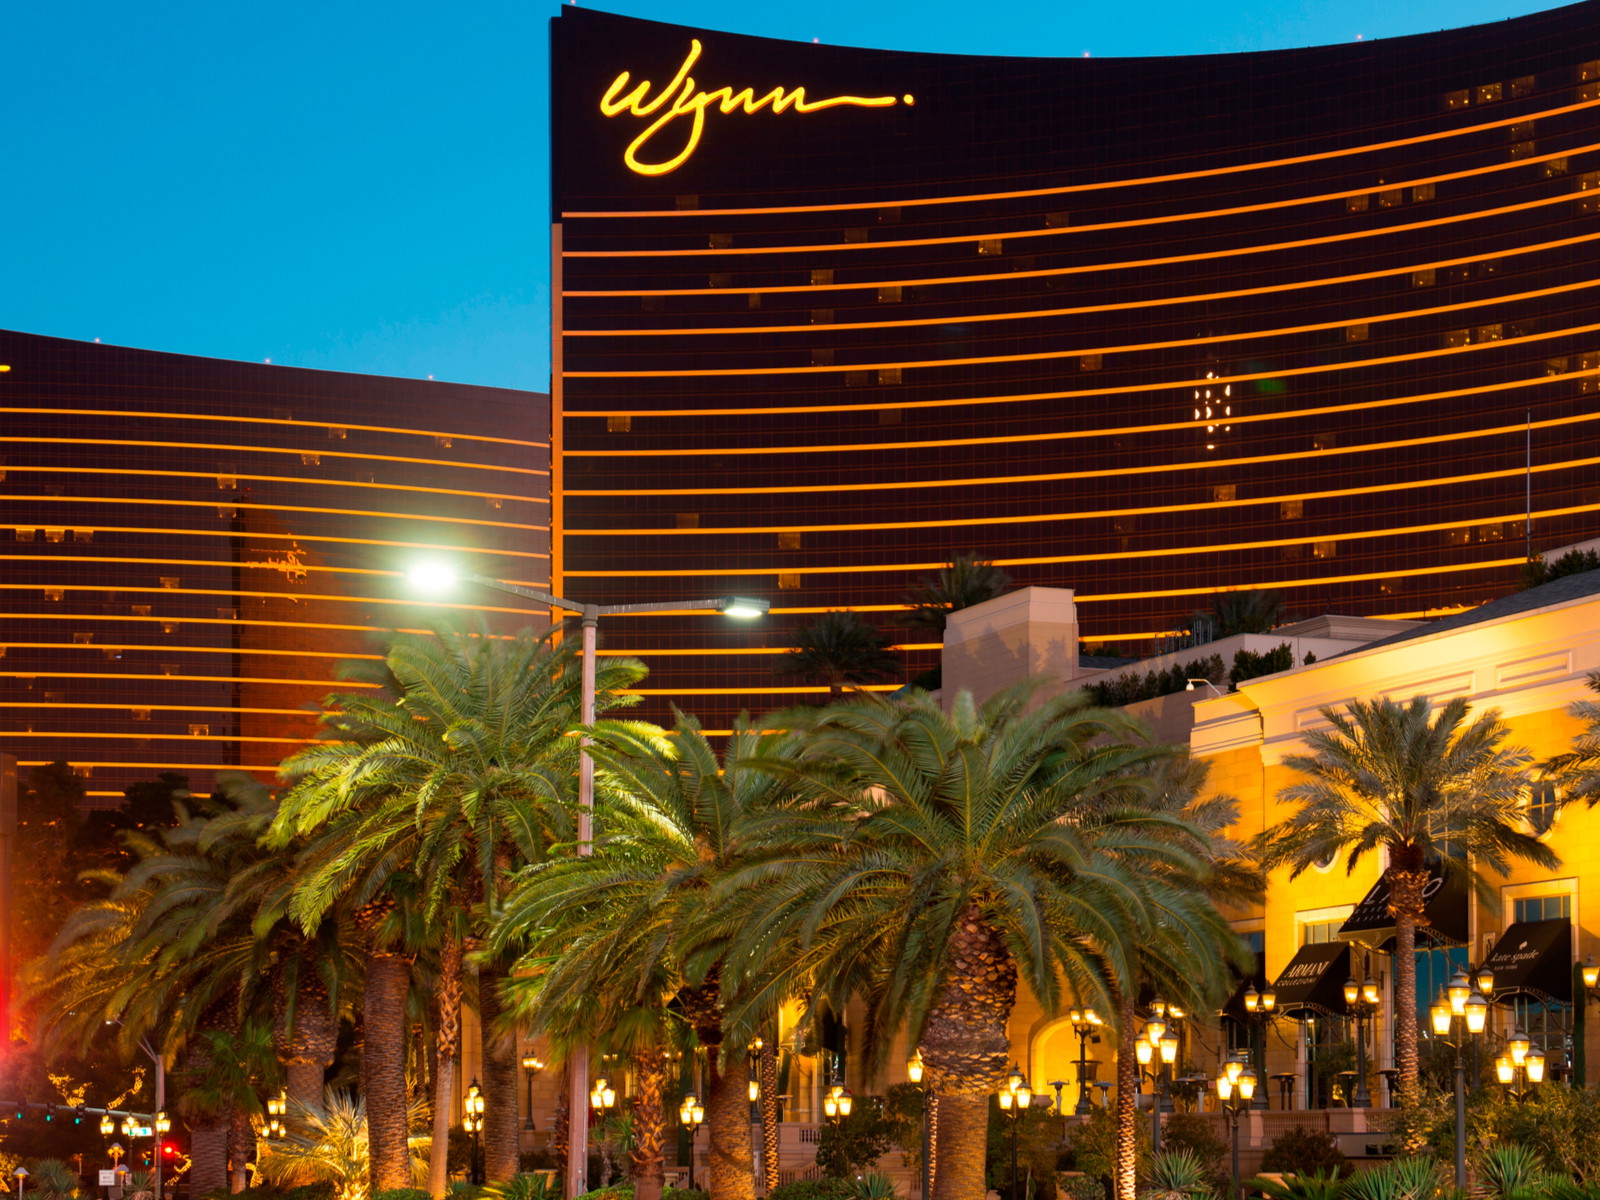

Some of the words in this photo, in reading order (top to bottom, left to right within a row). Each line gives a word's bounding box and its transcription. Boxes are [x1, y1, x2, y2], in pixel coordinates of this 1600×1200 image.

[1364, 877, 1443, 905] LO
[1490, 952, 1511, 962] kate
[1511, 949, 1539, 963] spade
[1283, 961, 1330, 978] ARMANI
